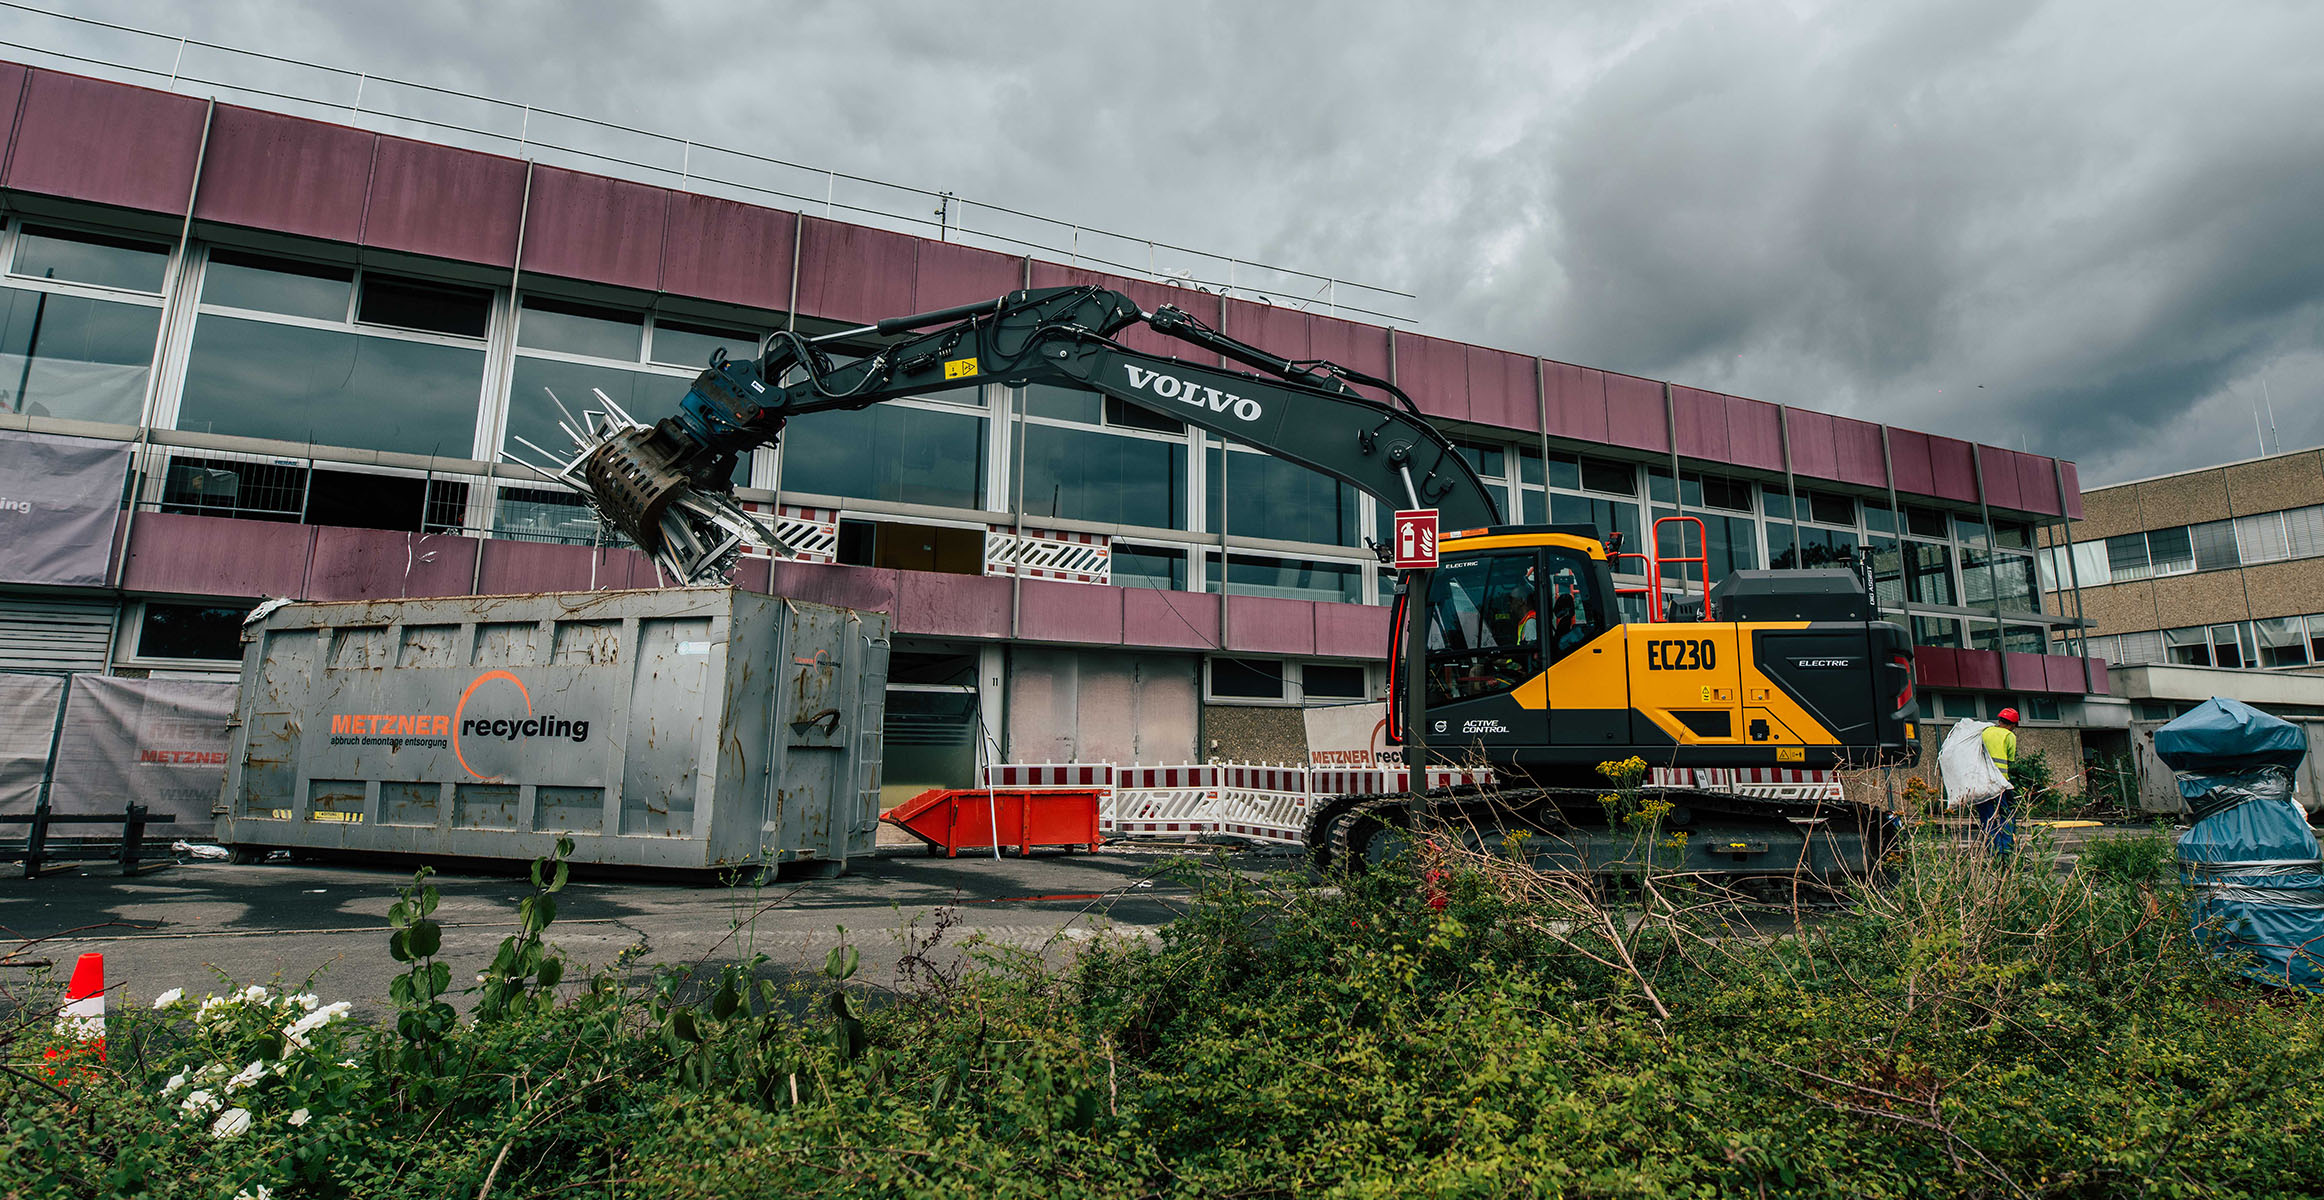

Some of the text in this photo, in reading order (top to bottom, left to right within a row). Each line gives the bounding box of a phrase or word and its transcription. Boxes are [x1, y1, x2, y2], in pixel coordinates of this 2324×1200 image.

[1124, 364, 1262, 421] VOLVO
[1445, 561, 1479, 569] ELECTRIC
[1647, 639, 1716, 671] EC230
[992, 677, 999, 687] 11
[331, 714, 590, 742] METZNER recycling
[330, 736, 448, 749] abbruch demontage entsorgung
[1312, 750, 1369, 763] METZNER
